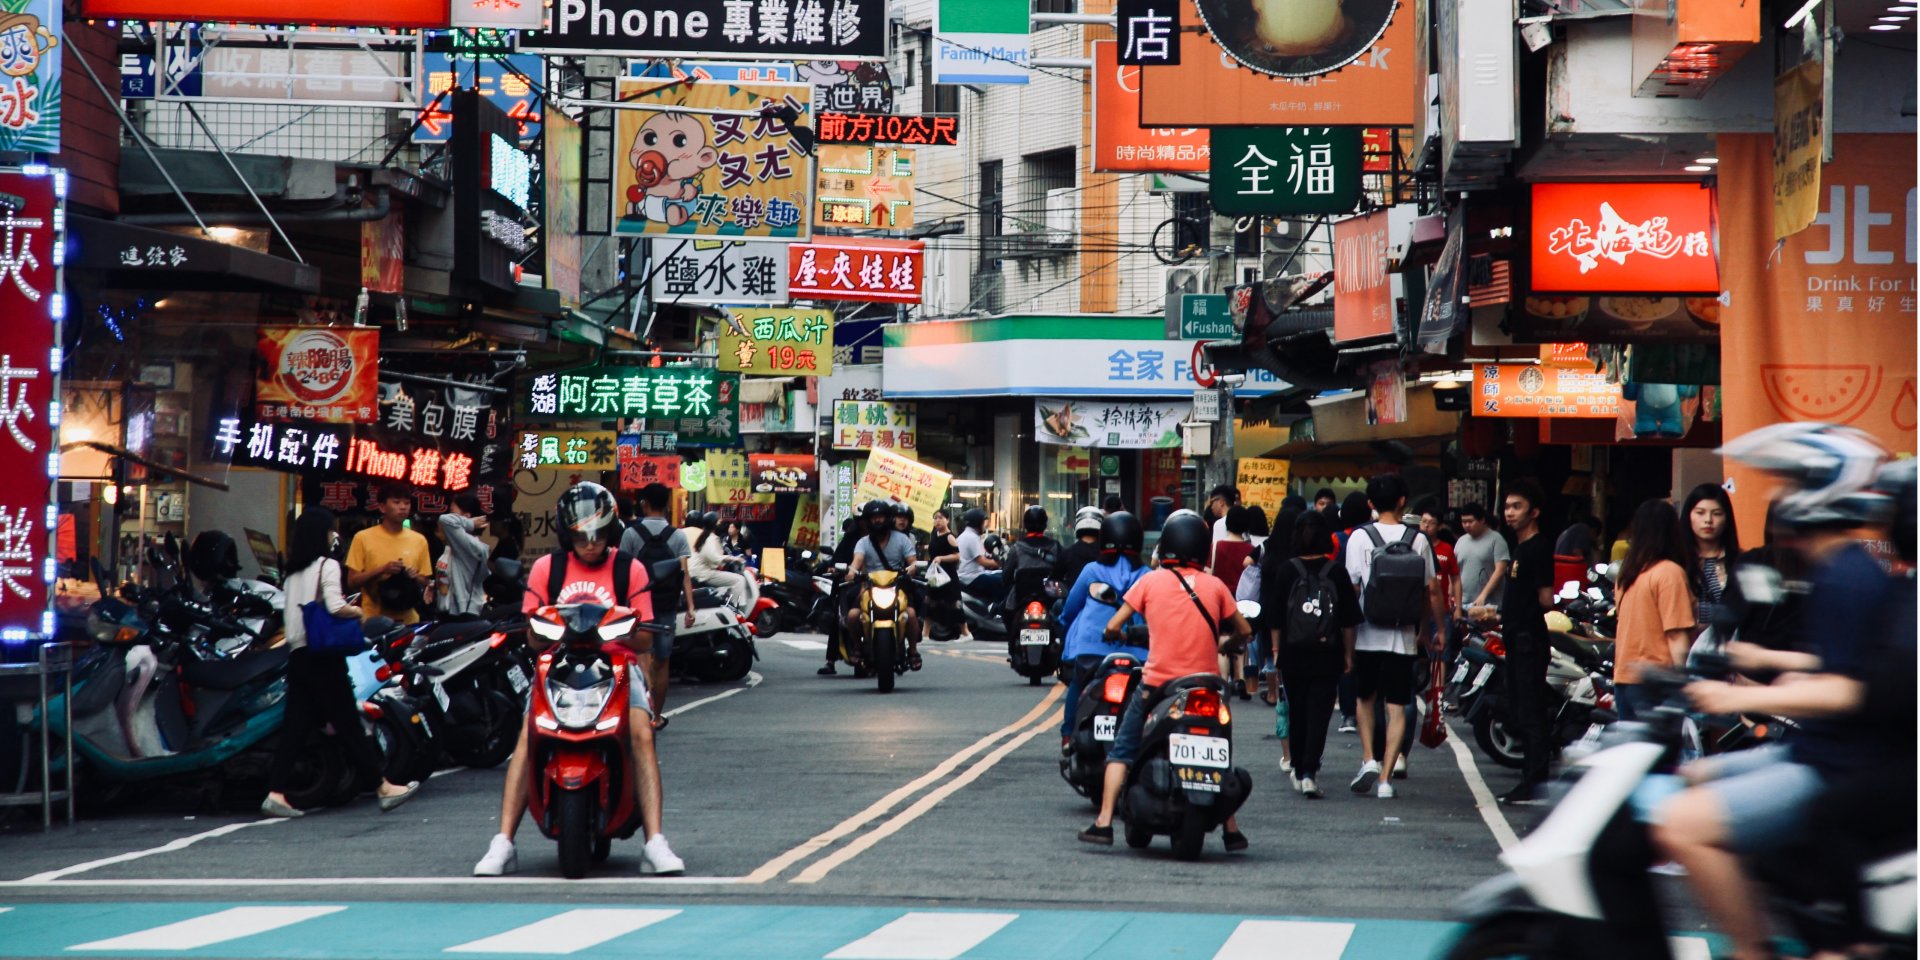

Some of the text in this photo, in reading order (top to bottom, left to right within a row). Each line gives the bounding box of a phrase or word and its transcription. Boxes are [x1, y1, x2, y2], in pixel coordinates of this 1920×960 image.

[543, 0, 861, 46] iPhone 專業維修
[1124, 9, 1172, 60] 店
[940, 45, 1028, 64] FamilyMart
[819, 113, 958, 144] 前方10公尺
[1233, 143, 1335, 195] 全福
[696, 193, 800, 228] 夾樂趣
[664, 255, 777, 296] 鹽水雞
[1808, 275, 1861, 291] Drink
[1869, 276, 1902, 291] For
[753, 315, 830, 345] 西瓜汁
[768, 346, 817, 371] 19元
[1108, 349, 1164, 381] 全家
[559, 374, 712, 415] 阿宗青草茶
[837, 403, 916, 427] 楊桃汁
[832, 429, 917, 450] 上海湯包
[346, 435, 407, 481] iPhone
[409, 446, 473, 492] 維修
